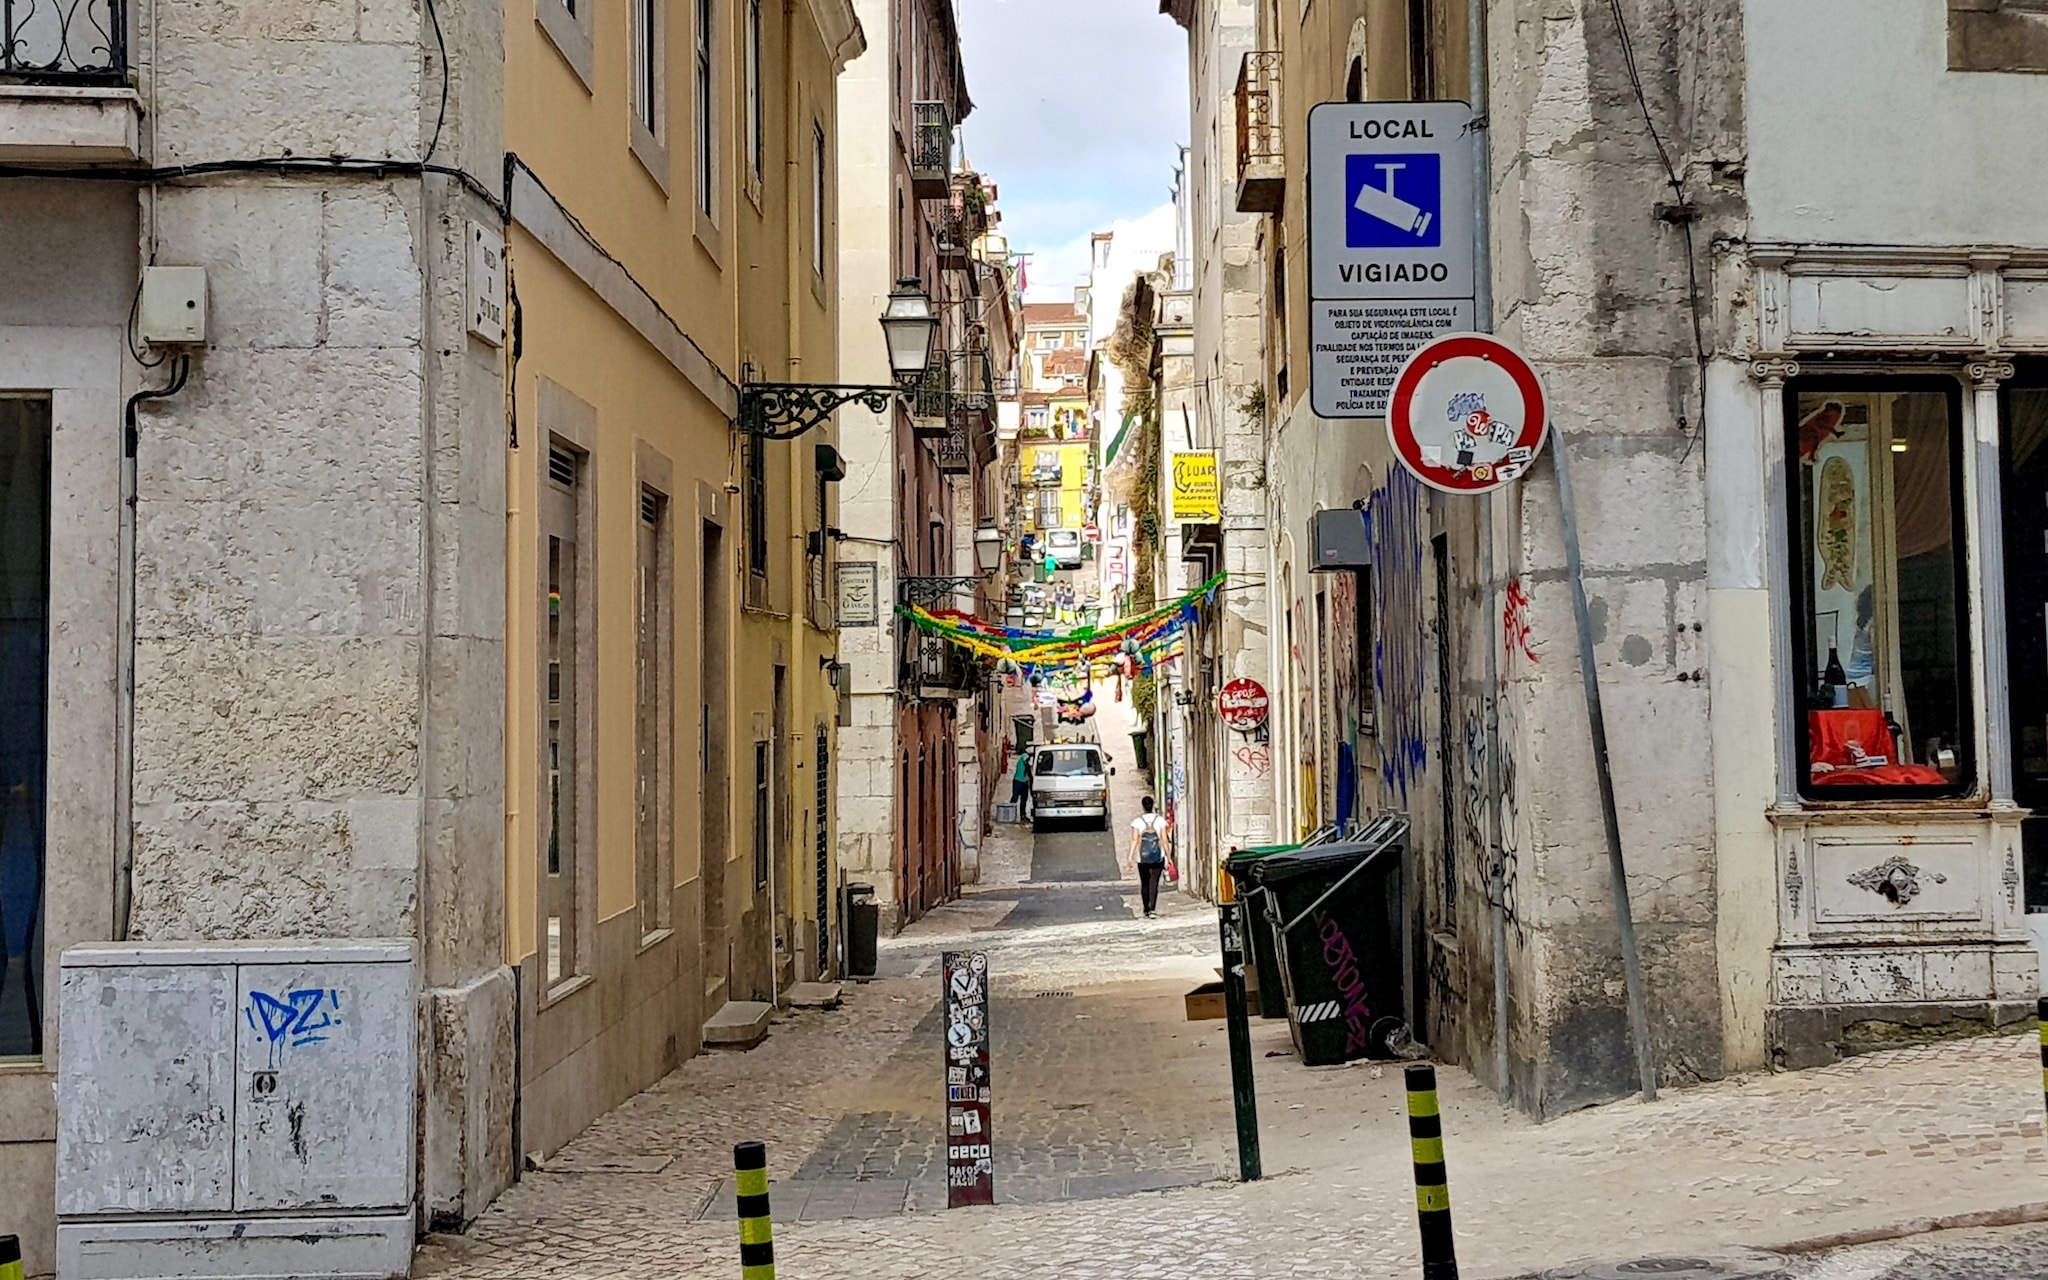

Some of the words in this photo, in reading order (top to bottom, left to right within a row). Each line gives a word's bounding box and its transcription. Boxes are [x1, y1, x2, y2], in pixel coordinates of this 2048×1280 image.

[1350, 120, 1434, 139] LOCAL
[1338, 263, 1448, 283] VIGIADO
[1328, 309, 1347, 318] PARA
[1349, 308, 1364, 318] SUA
[1365, 308, 1408, 319] SEGURANÇA
[1410, 307, 1427, 317] ESTE
[1428, 307, 1451, 317] LOCAL
[1334, 320, 1361, 329] OBJETO
[1363, 320, 1372, 329] DE
[1435, 319, 1452, 328] COM
[1351, 330, 1388, 342] CAPTAÇÃO
[1390, 331, 1400, 340] DE
[1316, 343, 1358, 352] FINALIDADE
[1359, 343, 1373, 352] NOS
[1375, 343, 1404, 352] TERMOS
[1406, 343, 1416, 351] DA
[1336, 354, 1380, 364] SEGURANÇA
[1381, 354, 1391, 363] DE
[1350, 367, 1355, 375] E
[1356, 364, 1399, 376] PREVENÇÃO
[1341, 378, 1375, 387] ENTIDADE
[1336, 400, 1364, 410] POLÍCIA
[1365, 401, 1375, 410] DE
